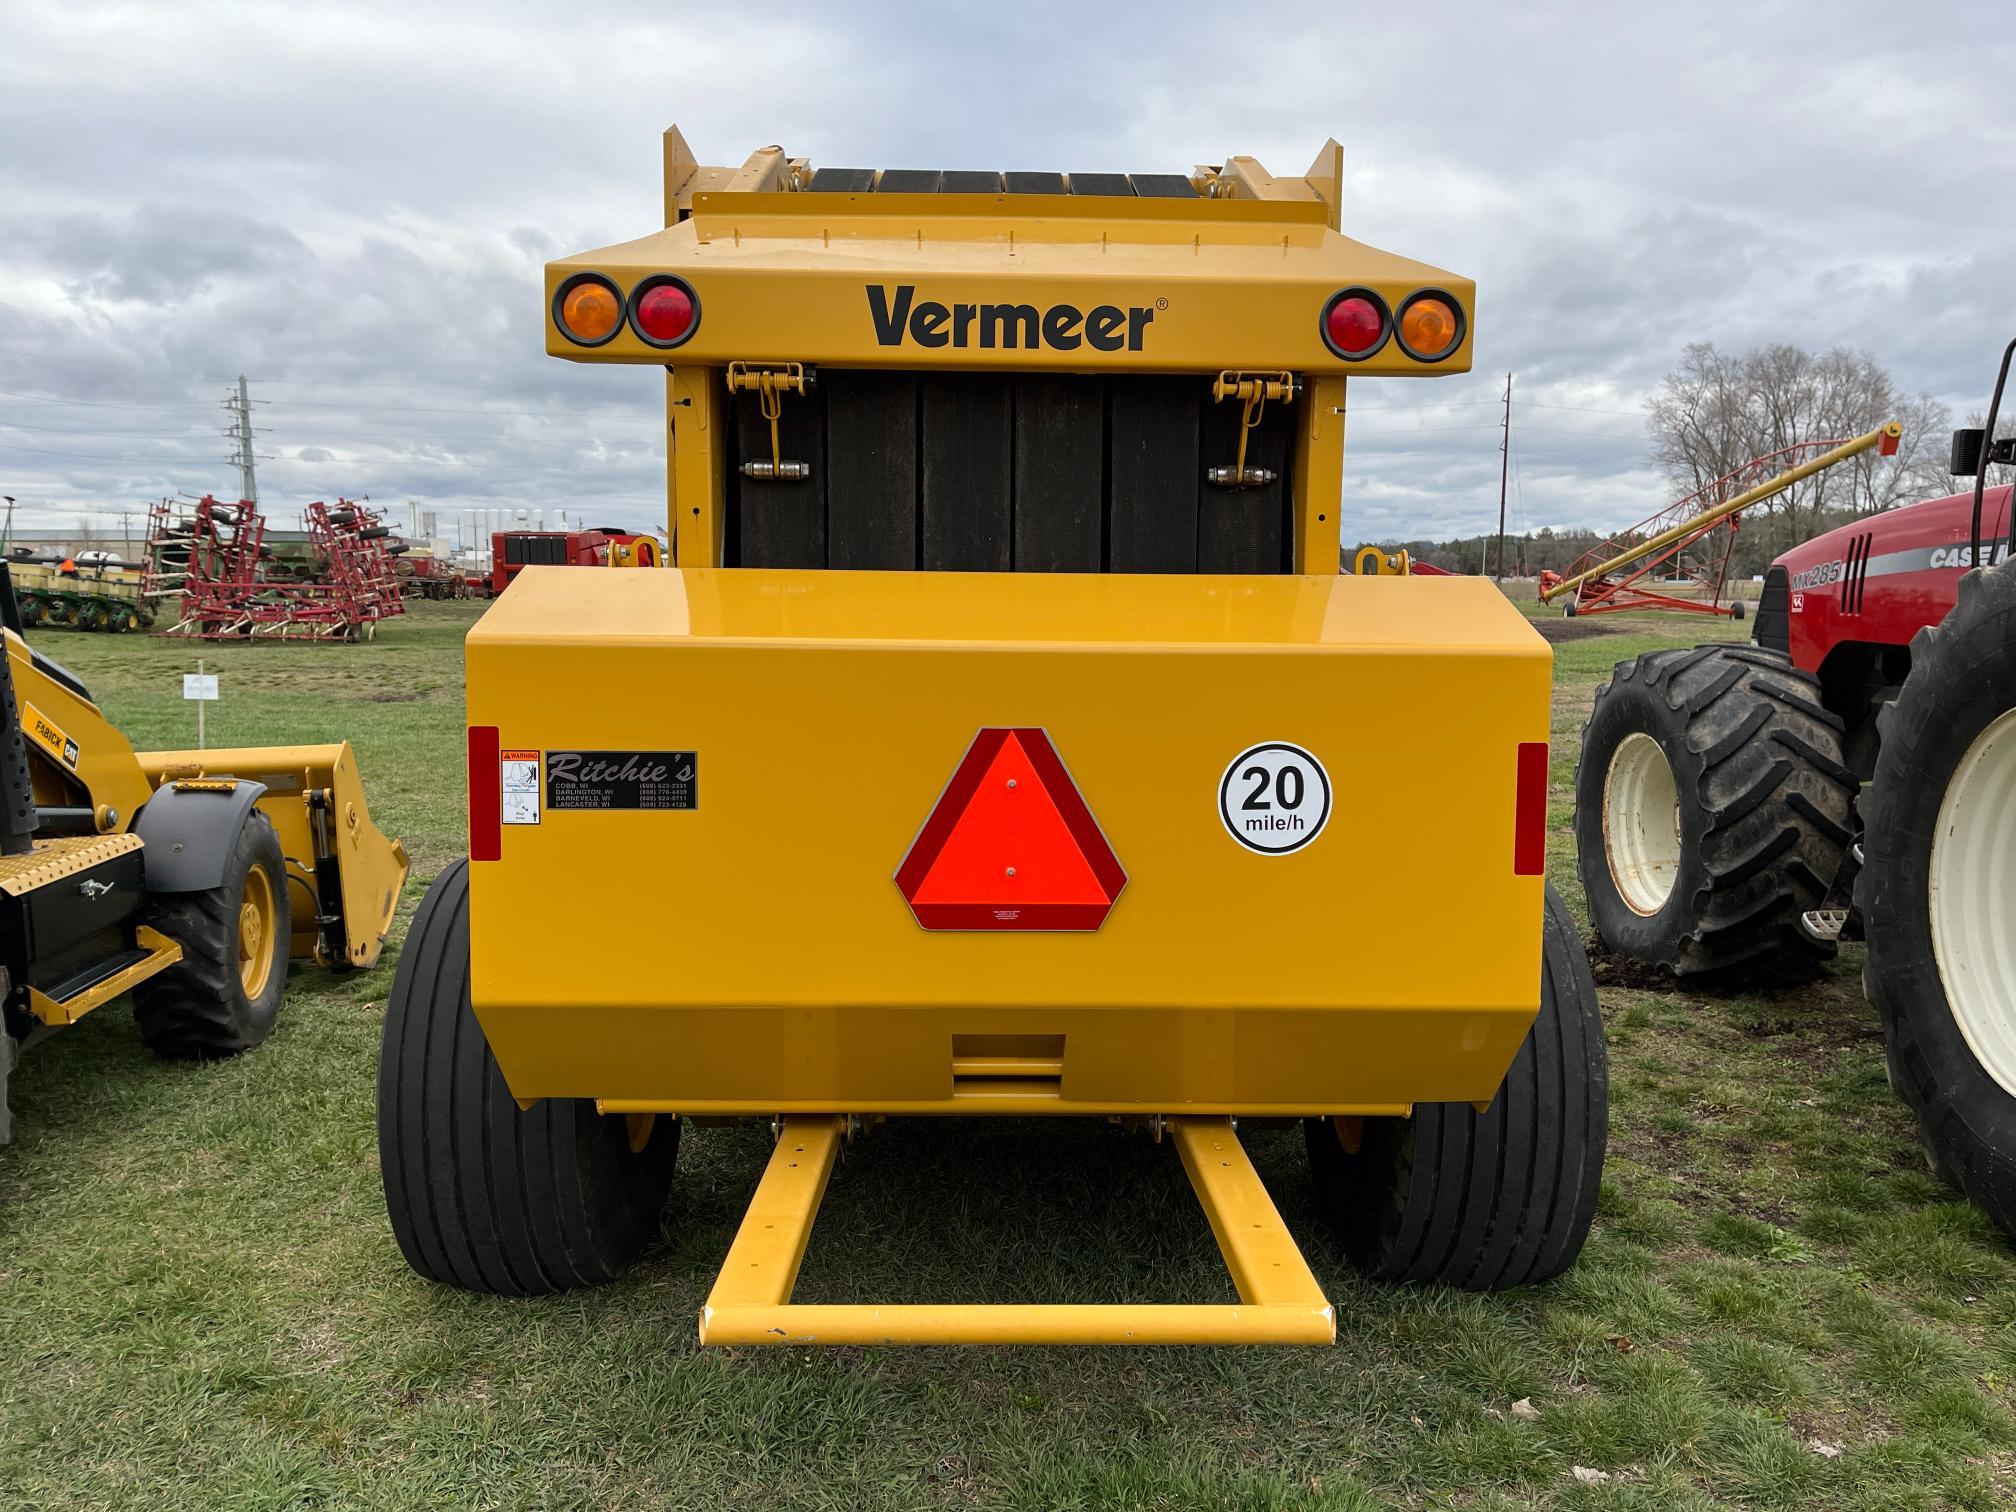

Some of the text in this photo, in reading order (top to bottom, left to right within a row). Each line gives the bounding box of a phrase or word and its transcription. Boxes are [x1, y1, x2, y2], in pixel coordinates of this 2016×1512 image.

[866, 284, 1154, 351] Vermeer
[1792, 560, 1841, 590] MX285
[35, 720, 62, 749] FABICK
[547, 753, 695, 782] Ritchie's
[1242, 766, 1304, 811] 20
[1246, 815, 1304, 831] mile/h
